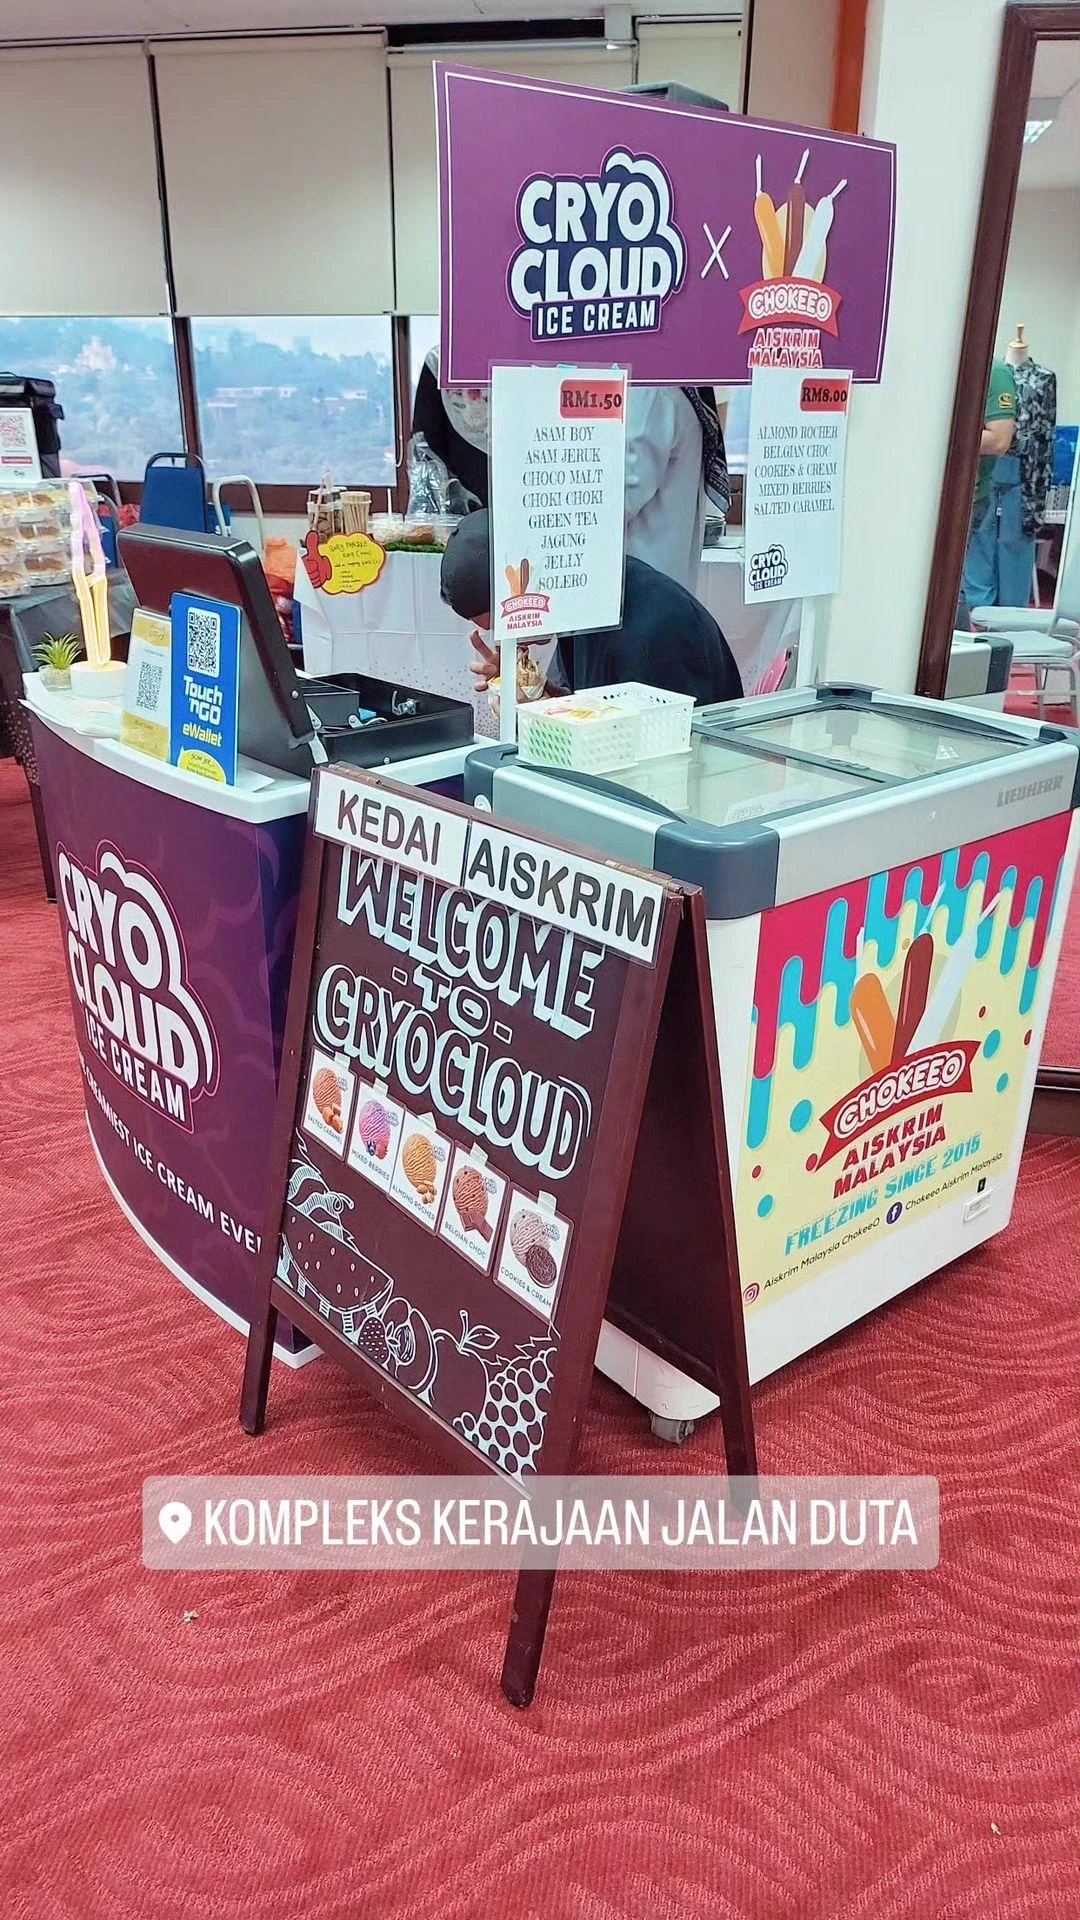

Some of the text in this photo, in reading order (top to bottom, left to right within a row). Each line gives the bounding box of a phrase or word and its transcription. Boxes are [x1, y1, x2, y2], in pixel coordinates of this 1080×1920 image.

[520, 180, 655, 244] CRYO
[511, 247, 672, 311] CLOUD
[748, 284, 833, 322] CHOKEEO
[537, 300, 656, 336] ICE CREAM
[753, 327, 821, 349] AISKRIM
[747, 347, 824, 369] MALAYSIA
[561, 389, 623, 410] RM1.50
[802, 386, 848, 403] RM8.00
[532, 426, 595, 443] ASAM BOY
[757, 425, 838, 440] ALMOND ROCHER
[524, 447, 601, 465] ASAM JERUK
[763, 444, 831, 459] BELGIAN CHOC
[522, 469, 604, 487] CHOCO MALT
[754, 464, 795, 478] COOKIES
[806, 462, 838, 476] CREAM
[522, 490, 604, 508] CHOKI CHOKI
[758, 481, 832, 497] MIXED BERRIES
[753, 499, 835, 516] SALTED CARAMEL
[528, 511, 598, 530] GREEN TEA
[540, 533, 586, 550] JAGUNG
[544, 553, 584, 570] JELLY
[751, 550, 781, 570] CRYO
[538, 572, 587, 591] SOLERO
[749, 565, 785, 586] CLOUD
[506, 620, 543, 630] MALAYSIA
[508, 612, 541, 622] AISKRIM
[183, 675, 223, 706] Touch
[182, 723, 223, 748] eWallet
[337, 788, 656, 949] KEDAI AISKRIM
[59, 852, 163, 990] CRYO
[337, 845, 606, 1041] WELCOME
[68, 930, 199, 1090] CLOUD
[85, 1007, 187, 1123] ICE CREAM
[316, 964, 588, 1180] CRYOCLOUD
[834, 1049, 966, 1139] CHOKEEO
[842, 1102, 944, 1172] AISKRIM
[833, 1124, 946, 1200] MALAYSIA
[132, 1136, 154, 1173] ICE
[157, 1161, 215, 1224] CREAM
[391, 1184, 435, 1221] ALMOND ROCHER
[784, 1132, 982, 1256] FREEZING SINCE 2015
[763, 1152, 1003, 1291] Aiskrim Malaysia ChokeeO Chokeeo Aiskrim Malaysia
[444, 1222, 487, 1260] BELGIAN CHOC
[500, 1265, 527, 1291] COOKIES
[531, 1288, 552, 1307] CREAM
